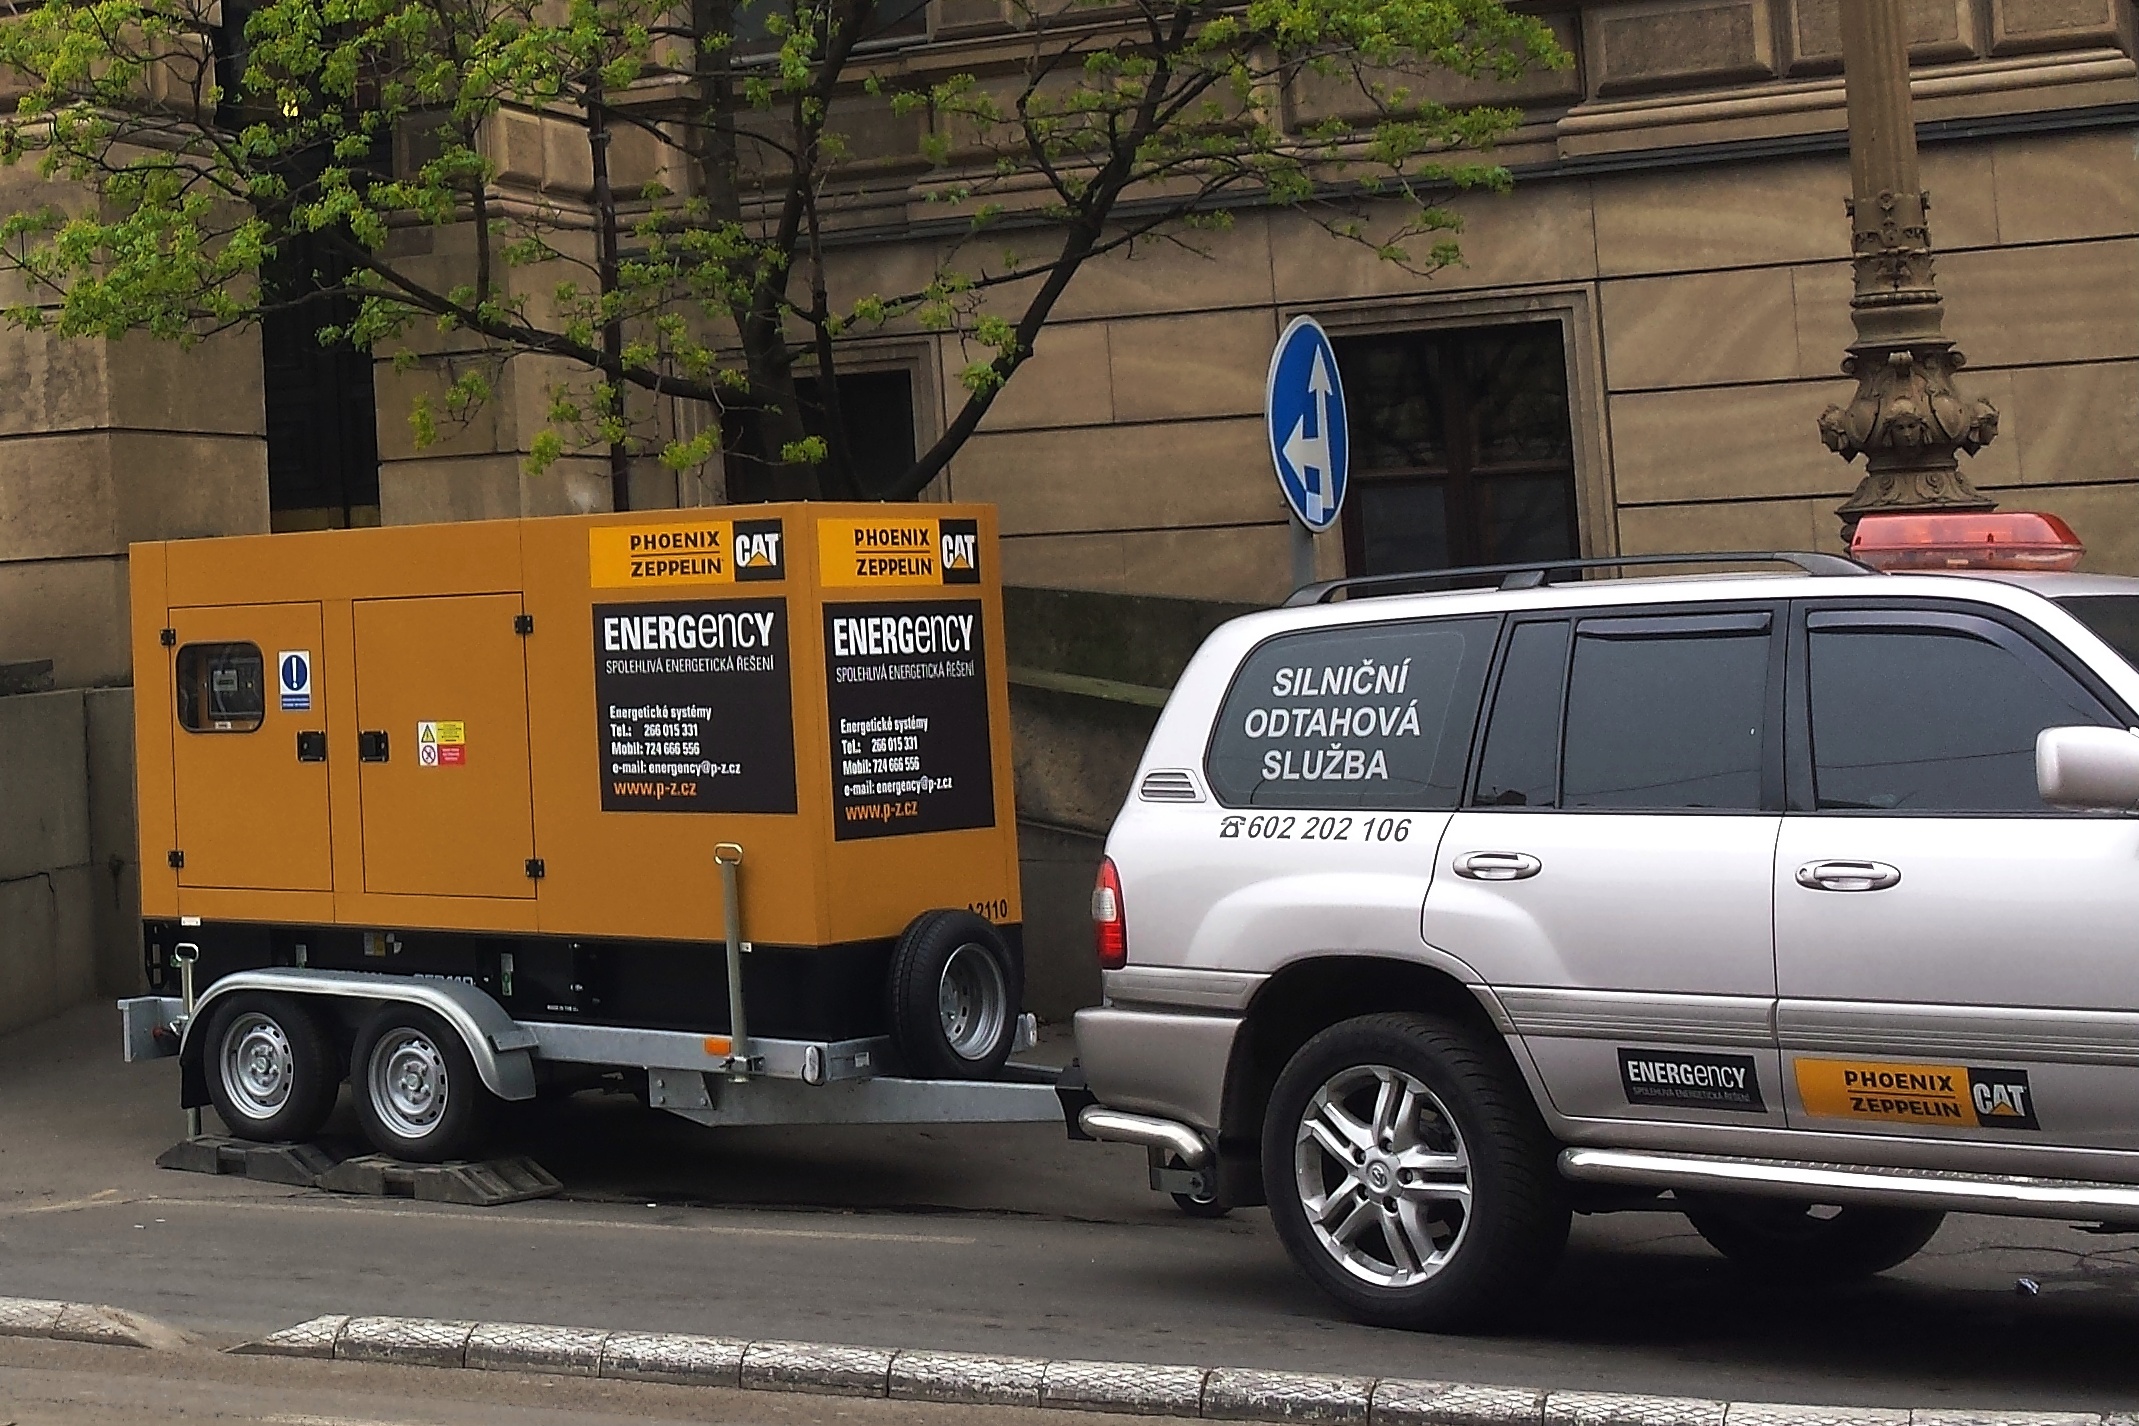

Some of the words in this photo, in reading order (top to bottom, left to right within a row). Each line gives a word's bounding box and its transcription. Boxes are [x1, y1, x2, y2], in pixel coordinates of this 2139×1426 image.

[630, 531, 720, 550] PHOENIX
[854, 528, 930, 546] PHOENIX
[735, 533, 779, 567] CAT
[941, 534, 976, 570] CAT
[630, 559, 722, 577] ZEPPELIN
[856, 558, 933, 576] ZEPPELIN
[606, 657, 663, 675] SPOLEHLIVÁ
[665, 655, 734, 673] ENERGETICKÁ
[736, 654, 775, 671] ŘEŠENÍ
[836, 663, 888, 683] SPOLEHLIVÁ
[888, 661, 945, 680] ENERGETICKÁ
[1272, 658, 1412, 697] SILNIČNÍ
[609, 704, 668, 721] Energetické
[670, 704, 712, 721] systémy
[1244, 699, 1421, 738] ODTAHOVÁ
[610, 723, 632, 737] Tel.:
[643, 723, 661, 737] 266
[662, 723, 680, 737] 015
[681, 723, 698, 737] 331
[840, 716, 893, 736] Energetické
[894, 715, 929, 734] systémy
[611, 741, 644, 756] Mobil:
[645, 741, 662, 756] 724
[663, 741, 681, 756] 666
[682, 741, 700, 756] 556
[871, 737, 887, 753] 266
[887, 736, 903, 752] 015
[904, 735, 918, 751] 331
[612, 760, 646, 774] e-mail:
[842, 759, 872, 776] Mobil:
[872, 757, 888, 774] 724
[888, 757, 904, 772] 666
[904, 756, 920, 771] 556
[1262, 743, 1389, 781] SLUŽBA
[613, 782, 697, 800] www.p-z.cz
[844, 779, 875, 797] e-mail:
[845, 801, 918, 823] www.p-z.cz
[1247, 816, 1296, 840] 602
[1300, 816, 1353, 841] 202
[1362, 817, 1412, 842] 106
[1844, 1070, 1954, 1092] PHOENIX
[1850, 1097, 1963, 1118] ZEPPELIN
[1973, 1083, 2026, 1117] CAT
